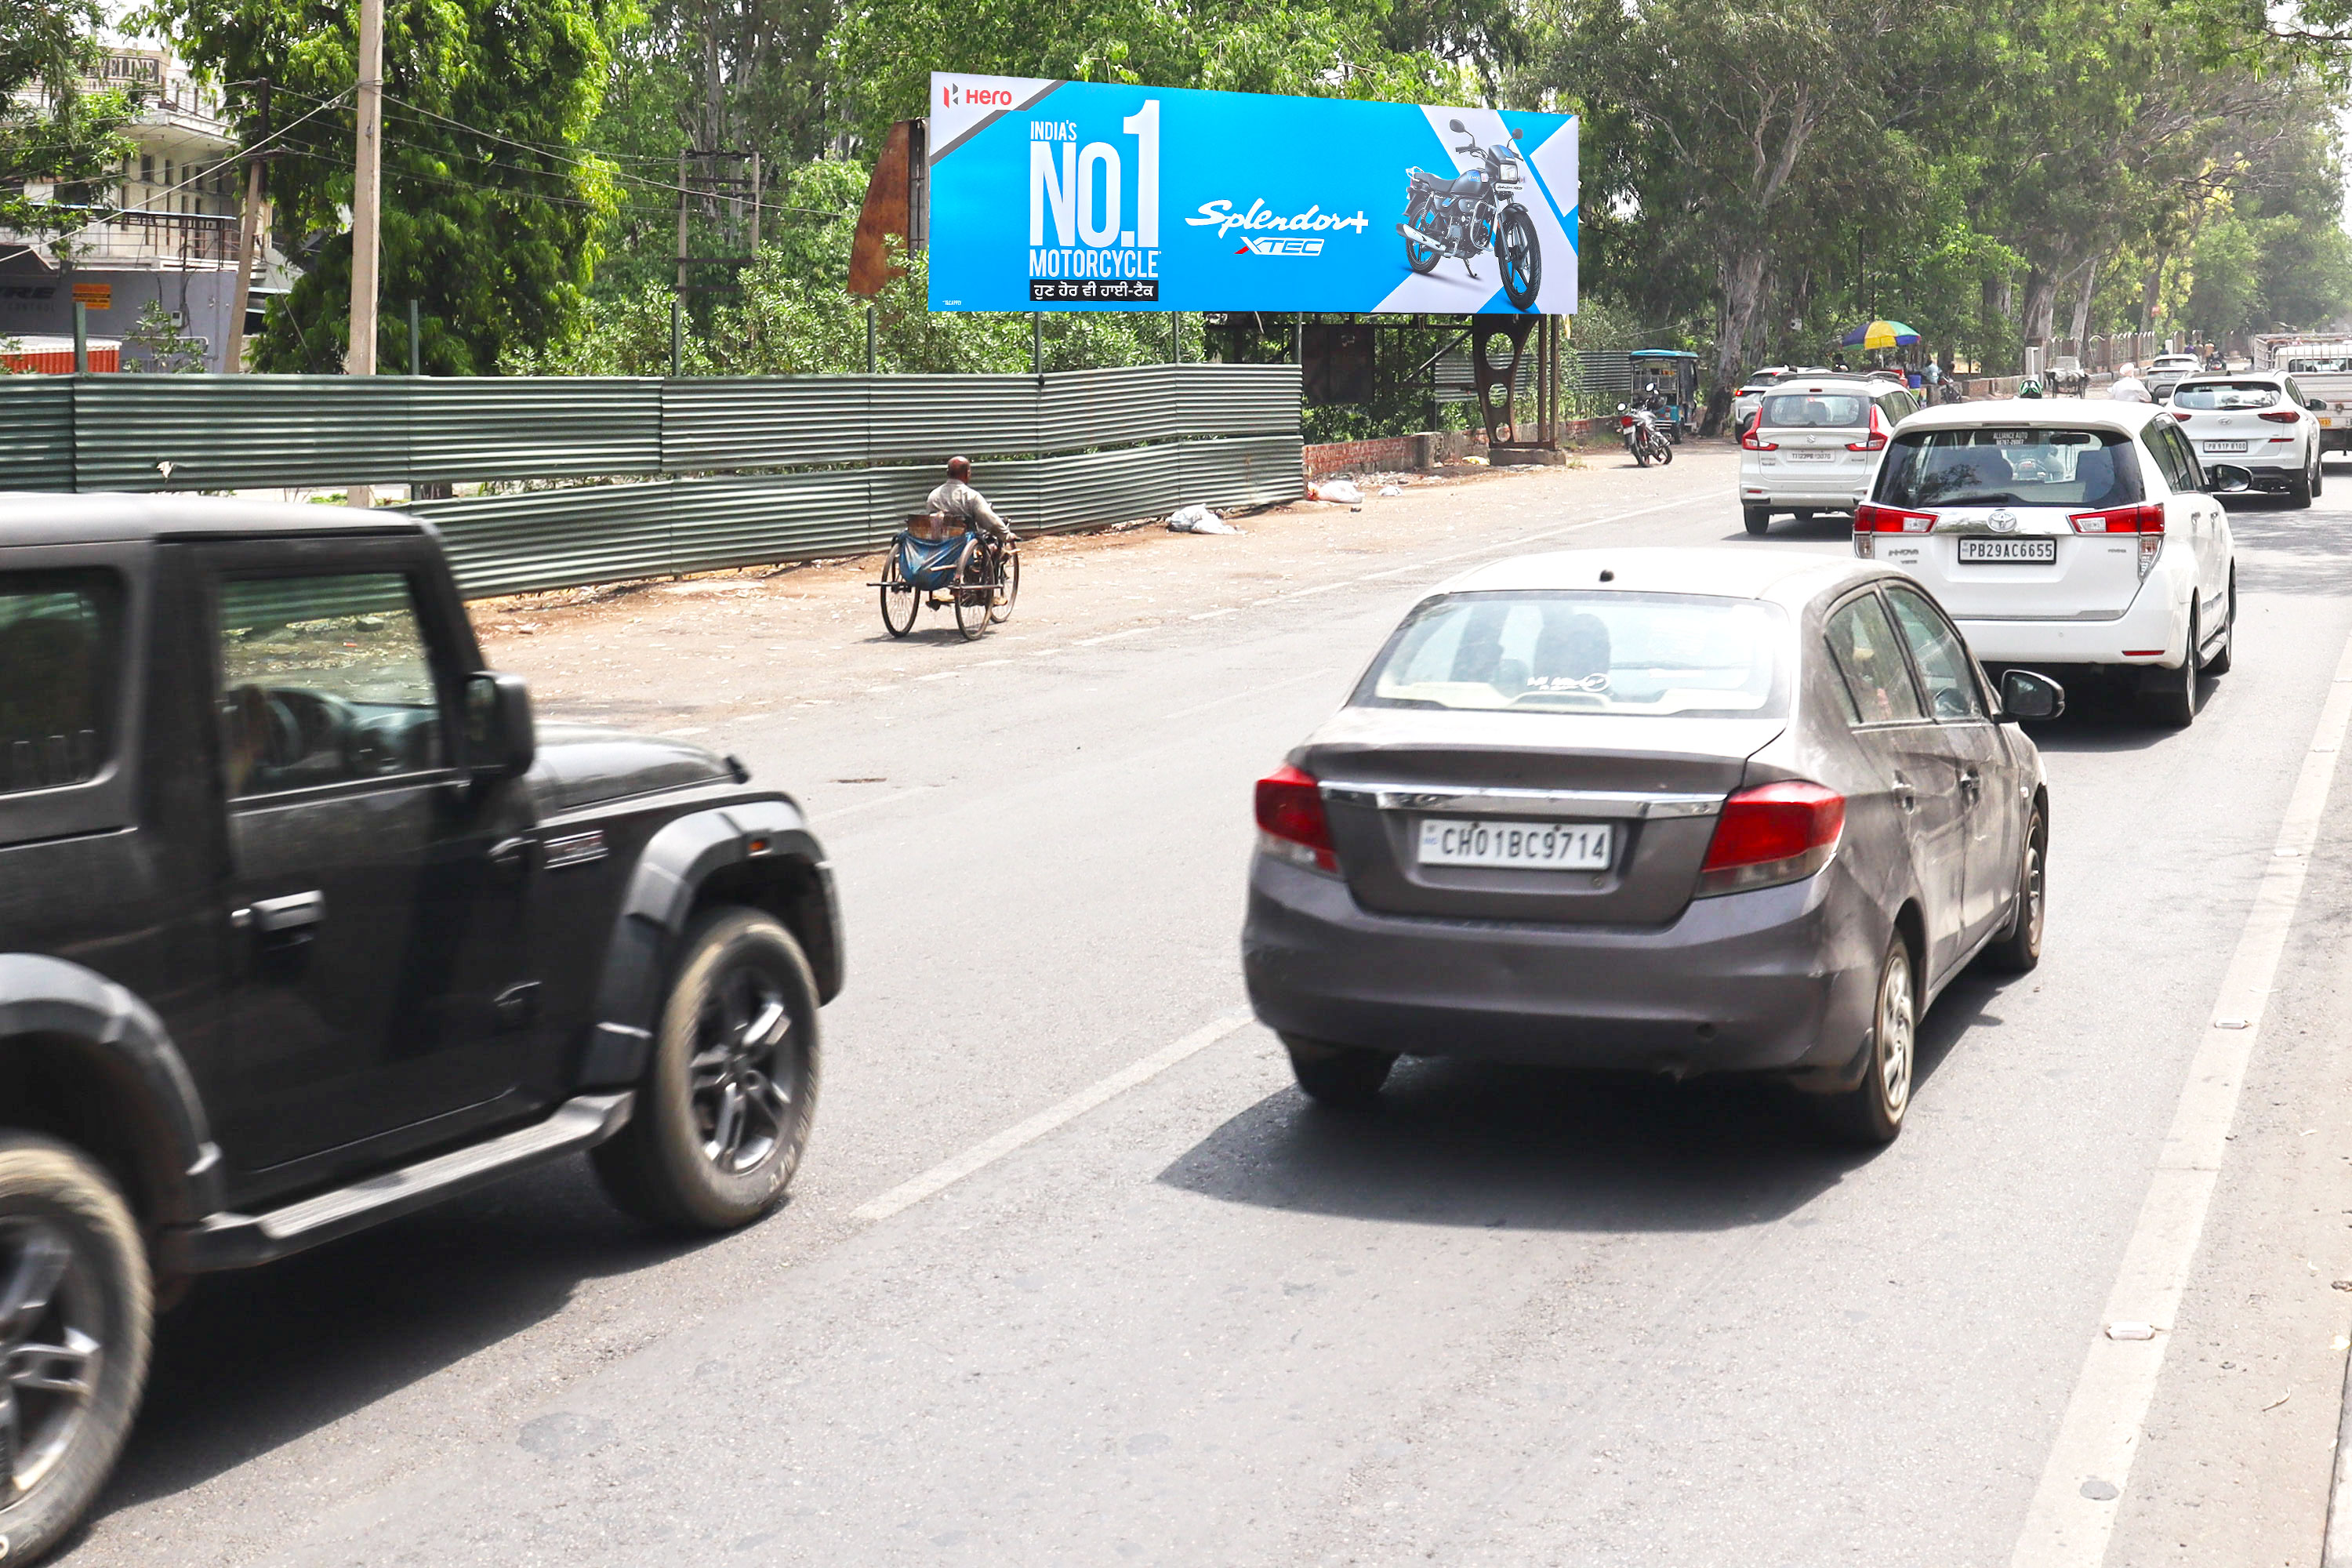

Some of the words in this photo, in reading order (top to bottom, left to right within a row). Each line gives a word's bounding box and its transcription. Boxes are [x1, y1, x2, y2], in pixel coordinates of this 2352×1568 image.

[966, 89, 1012, 106] Hero
[1030, 120, 1077, 141] INDIA'S
[1029, 100, 1160, 249] NO.1
[1233, 236, 1325, 256] XTEC
[1033, 284, 1055, 300] ਹੁਣ
[1058, 281, 1079, 297] ਹੋਰ
[1082, 281, 1097, 297] ਵੀ
[1969, 543, 2053, 557] PB29AC6655
[1442, 828, 1606, 861] CH01BC9714
